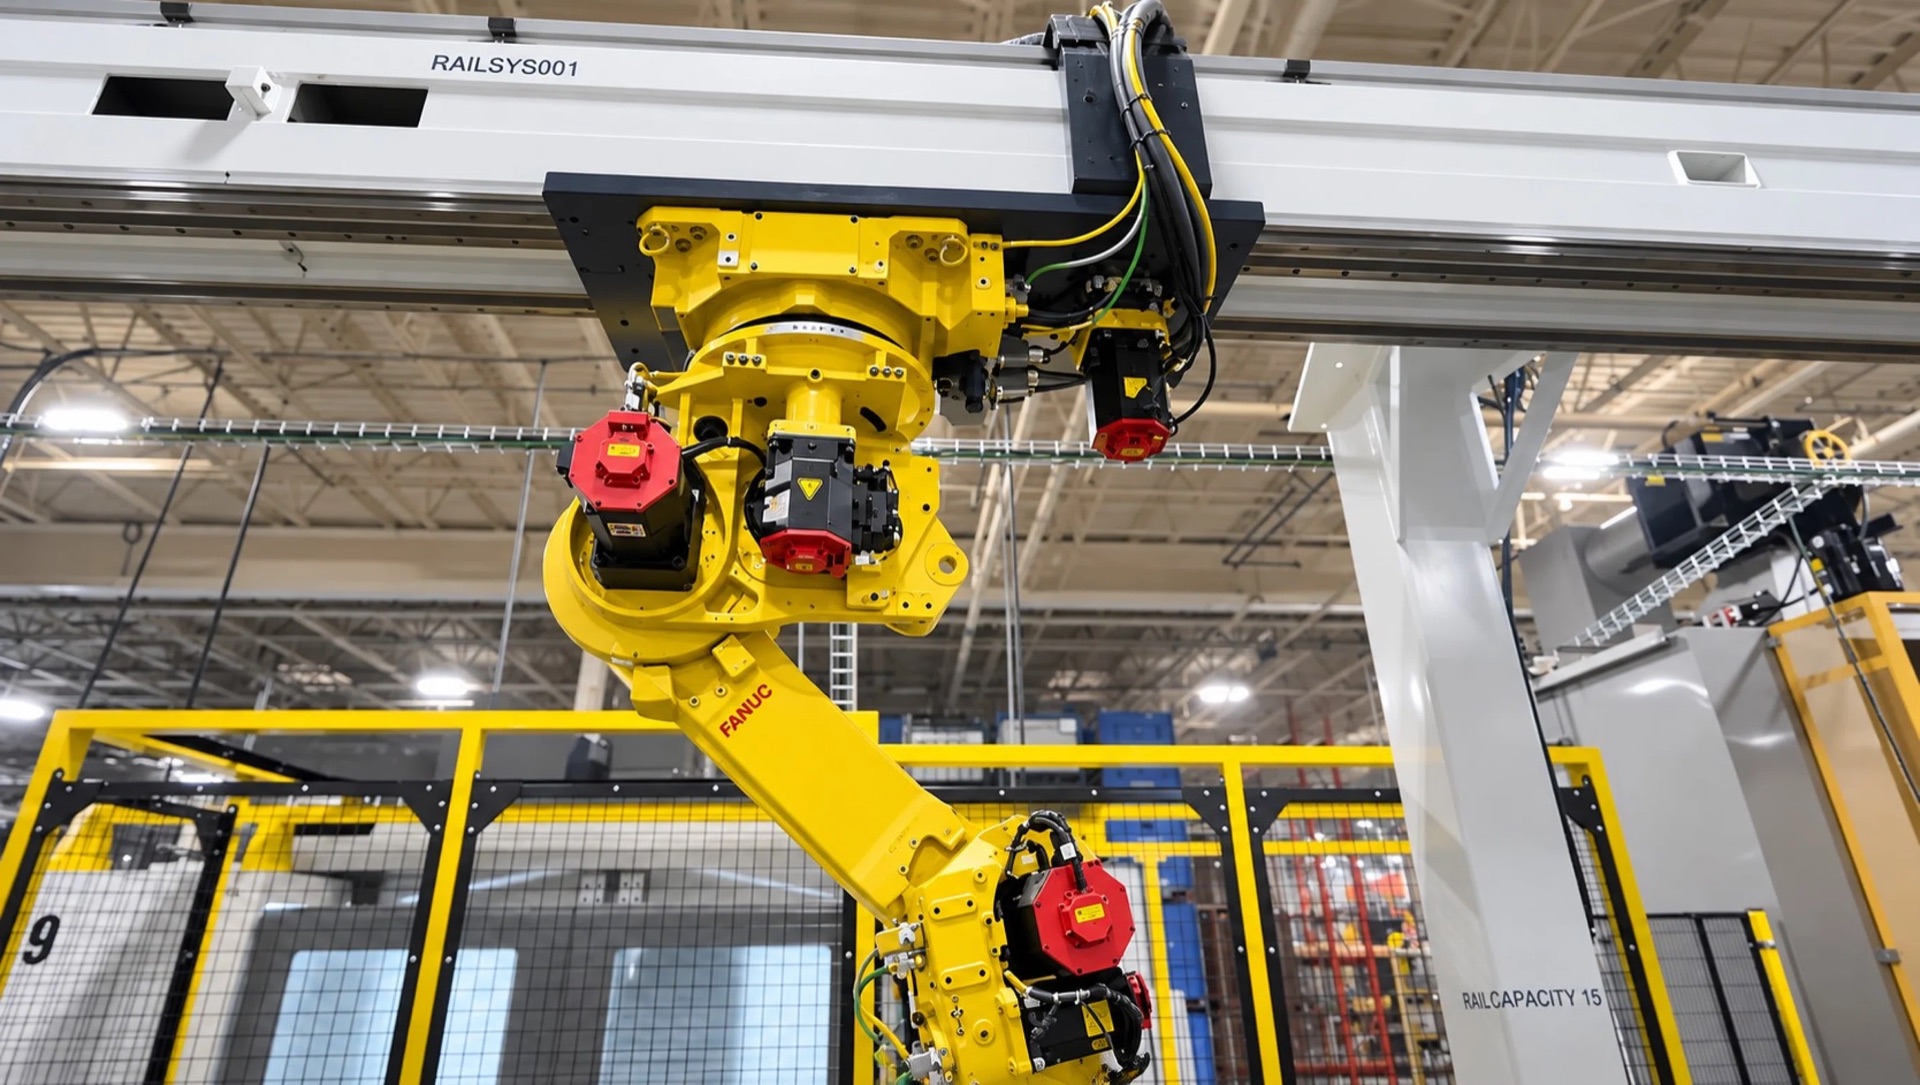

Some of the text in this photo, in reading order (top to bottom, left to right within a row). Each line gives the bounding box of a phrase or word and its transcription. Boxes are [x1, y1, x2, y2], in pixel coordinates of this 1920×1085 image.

[431, 54, 577, 77] RAILSYS001
[719, 684, 772, 738] FANUC
[22, 914, 60, 965] 9
[1462, 988, 1602, 1010] RAILCAPACITY 15
